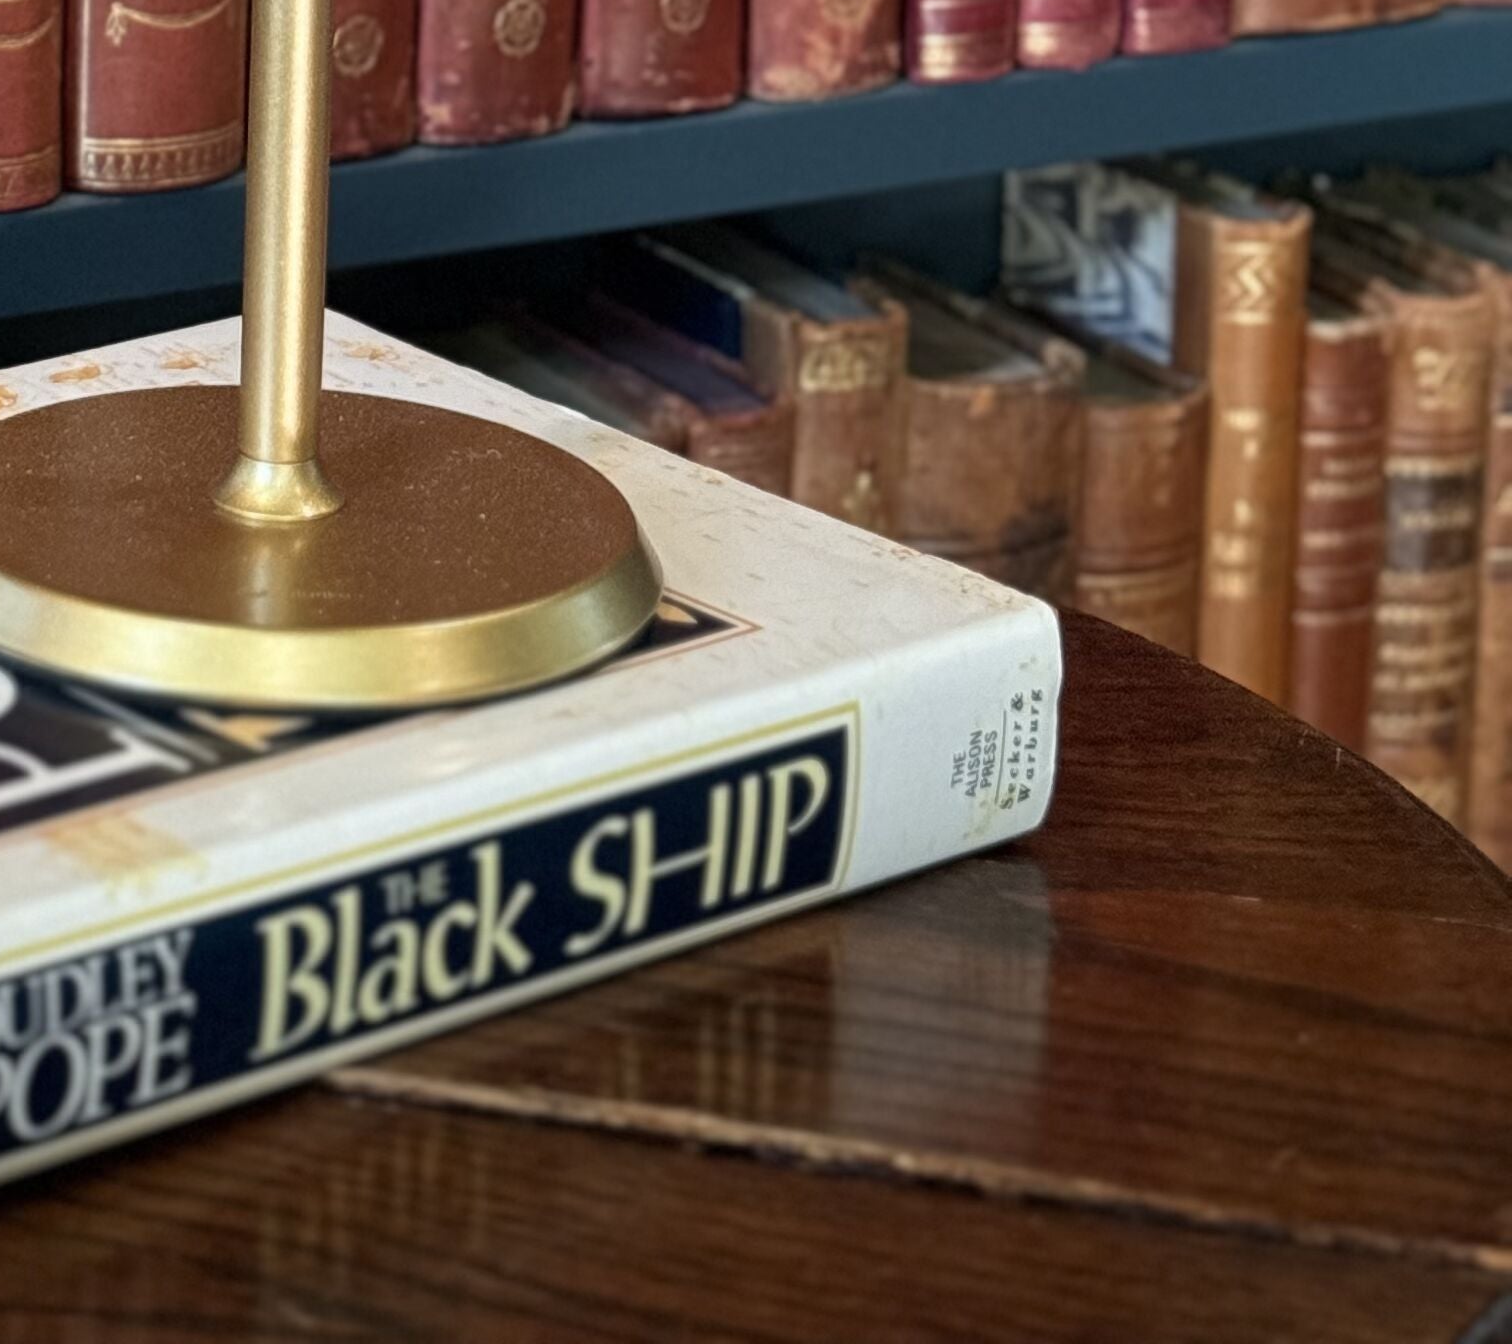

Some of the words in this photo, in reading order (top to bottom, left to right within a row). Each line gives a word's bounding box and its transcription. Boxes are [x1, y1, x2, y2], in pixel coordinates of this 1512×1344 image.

[1010, 691, 1024, 712] &
[950, 750, 967, 789] THE
[964, 728, 983, 798] ALISON
[979, 729, 998, 790] PRESS
[999, 720, 1023, 810] Secker
[1017, 688, 1044, 804] Warburg
[250, 841, 536, 1064] Black
[564, 755, 831, 959] SHIP
[380, 855, 452, 907] THE
